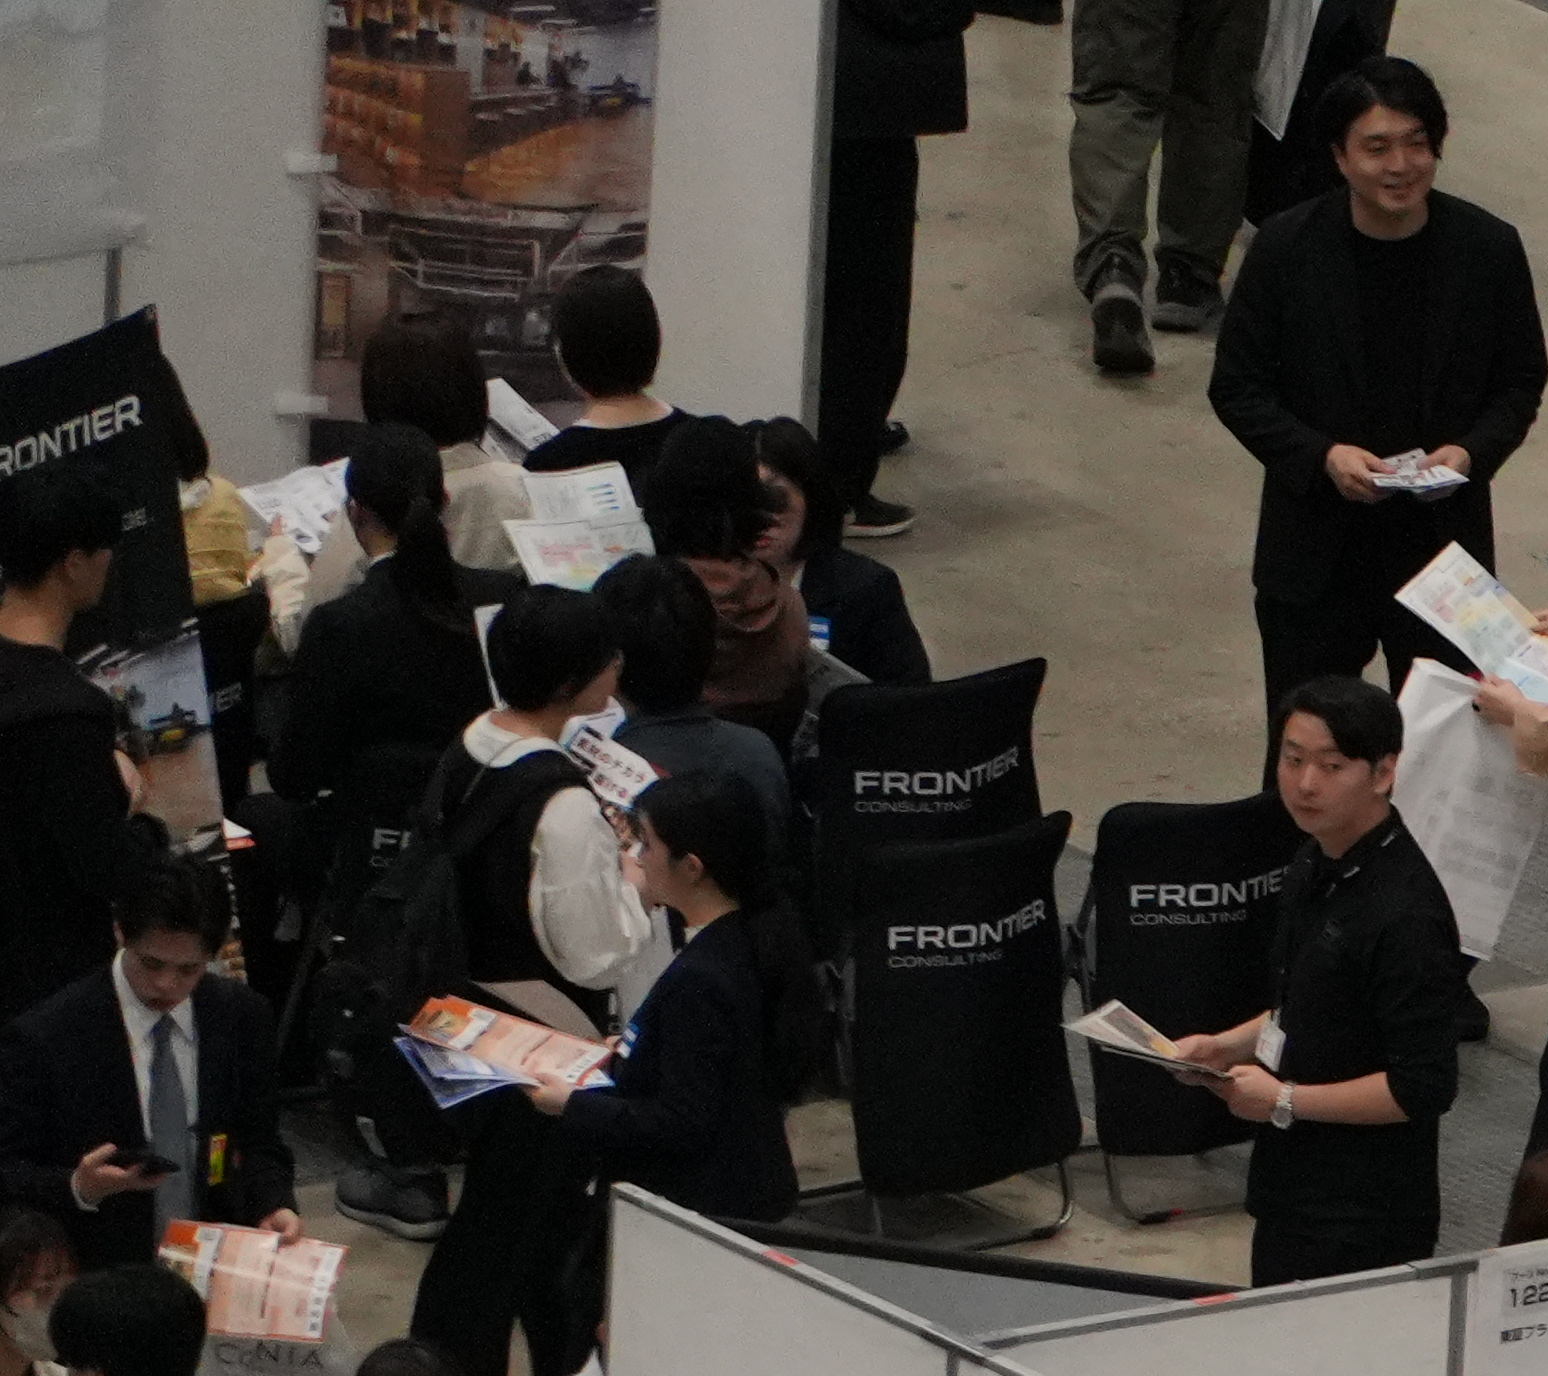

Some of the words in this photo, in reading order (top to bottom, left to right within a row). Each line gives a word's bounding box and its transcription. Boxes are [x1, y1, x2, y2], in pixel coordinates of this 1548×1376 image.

[854, 746, 1017, 797] FRONTIER
[853, 799, 972, 814] CONSULTING
[1129, 863, 1288, 908] FRONTIE
[887, 902, 1047, 949] FRONTIER
[1129, 903, 1248, 922] CONSULTING
[888, 951, 1002, 969] CONSULTING
